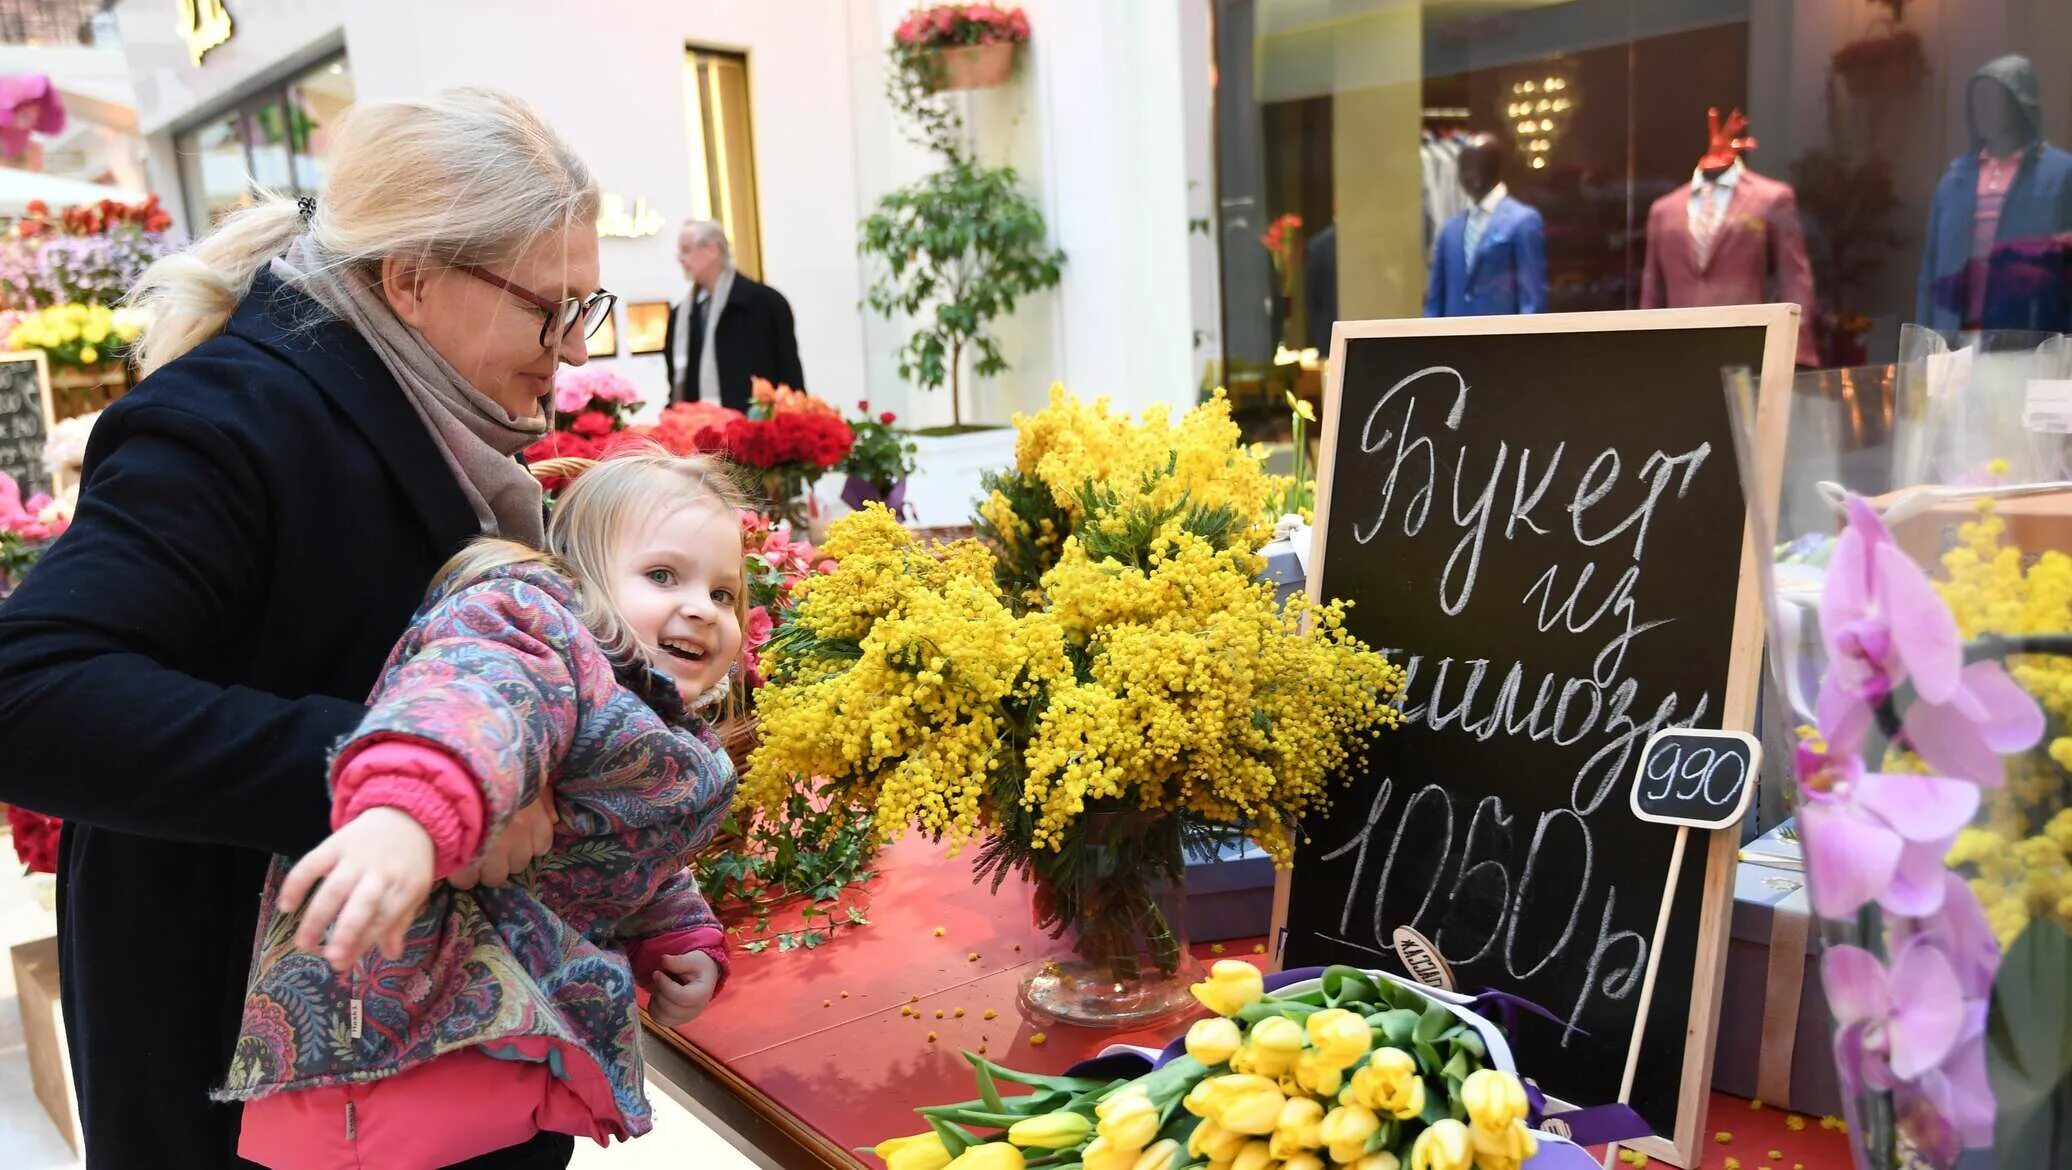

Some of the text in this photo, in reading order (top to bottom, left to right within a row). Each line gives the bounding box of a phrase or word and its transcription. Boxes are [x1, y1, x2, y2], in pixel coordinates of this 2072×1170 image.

[1354, 366, 1711, 616] Букет
[1522, 562, 1678, 689] из
[1647, 742, 1746, 805] 990
